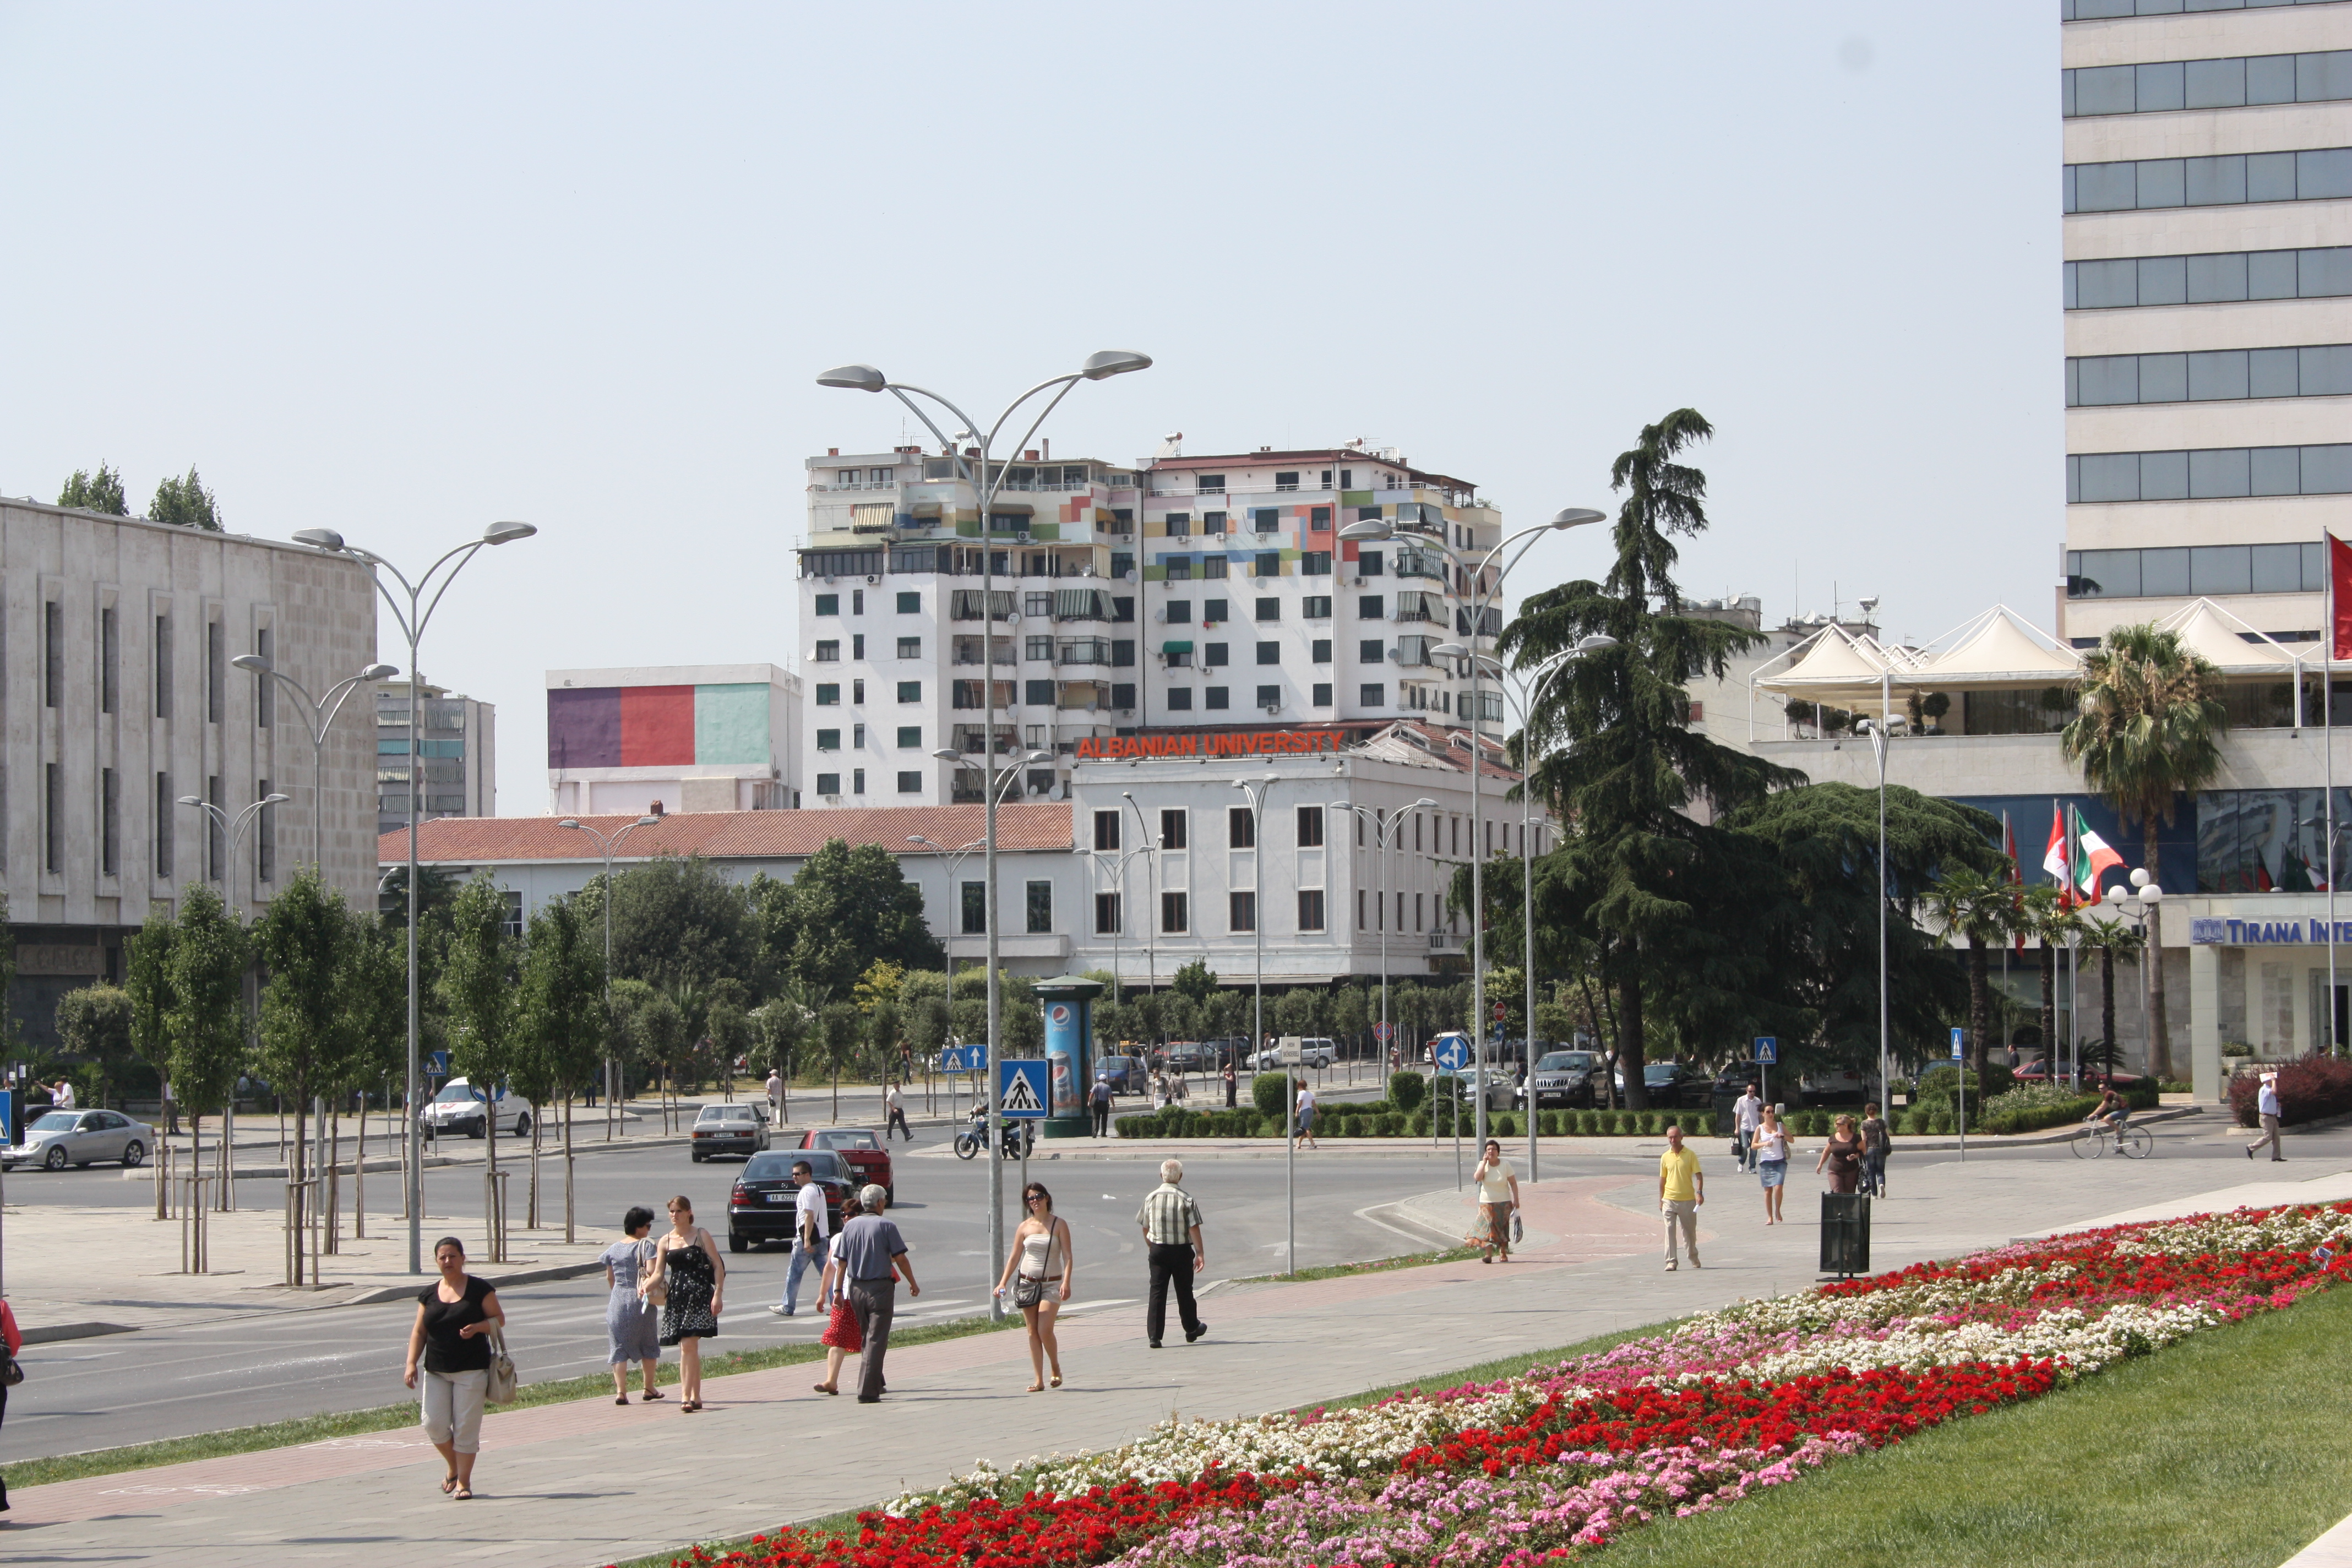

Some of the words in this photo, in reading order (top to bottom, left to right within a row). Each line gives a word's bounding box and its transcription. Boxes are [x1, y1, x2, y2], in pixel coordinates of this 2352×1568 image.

[1077, 735, 1197, 759] ALBANIAN
[1204, 731, 1345, 755] UNIVERSITY
[2226, 919, 2302, 943] TIRANA
